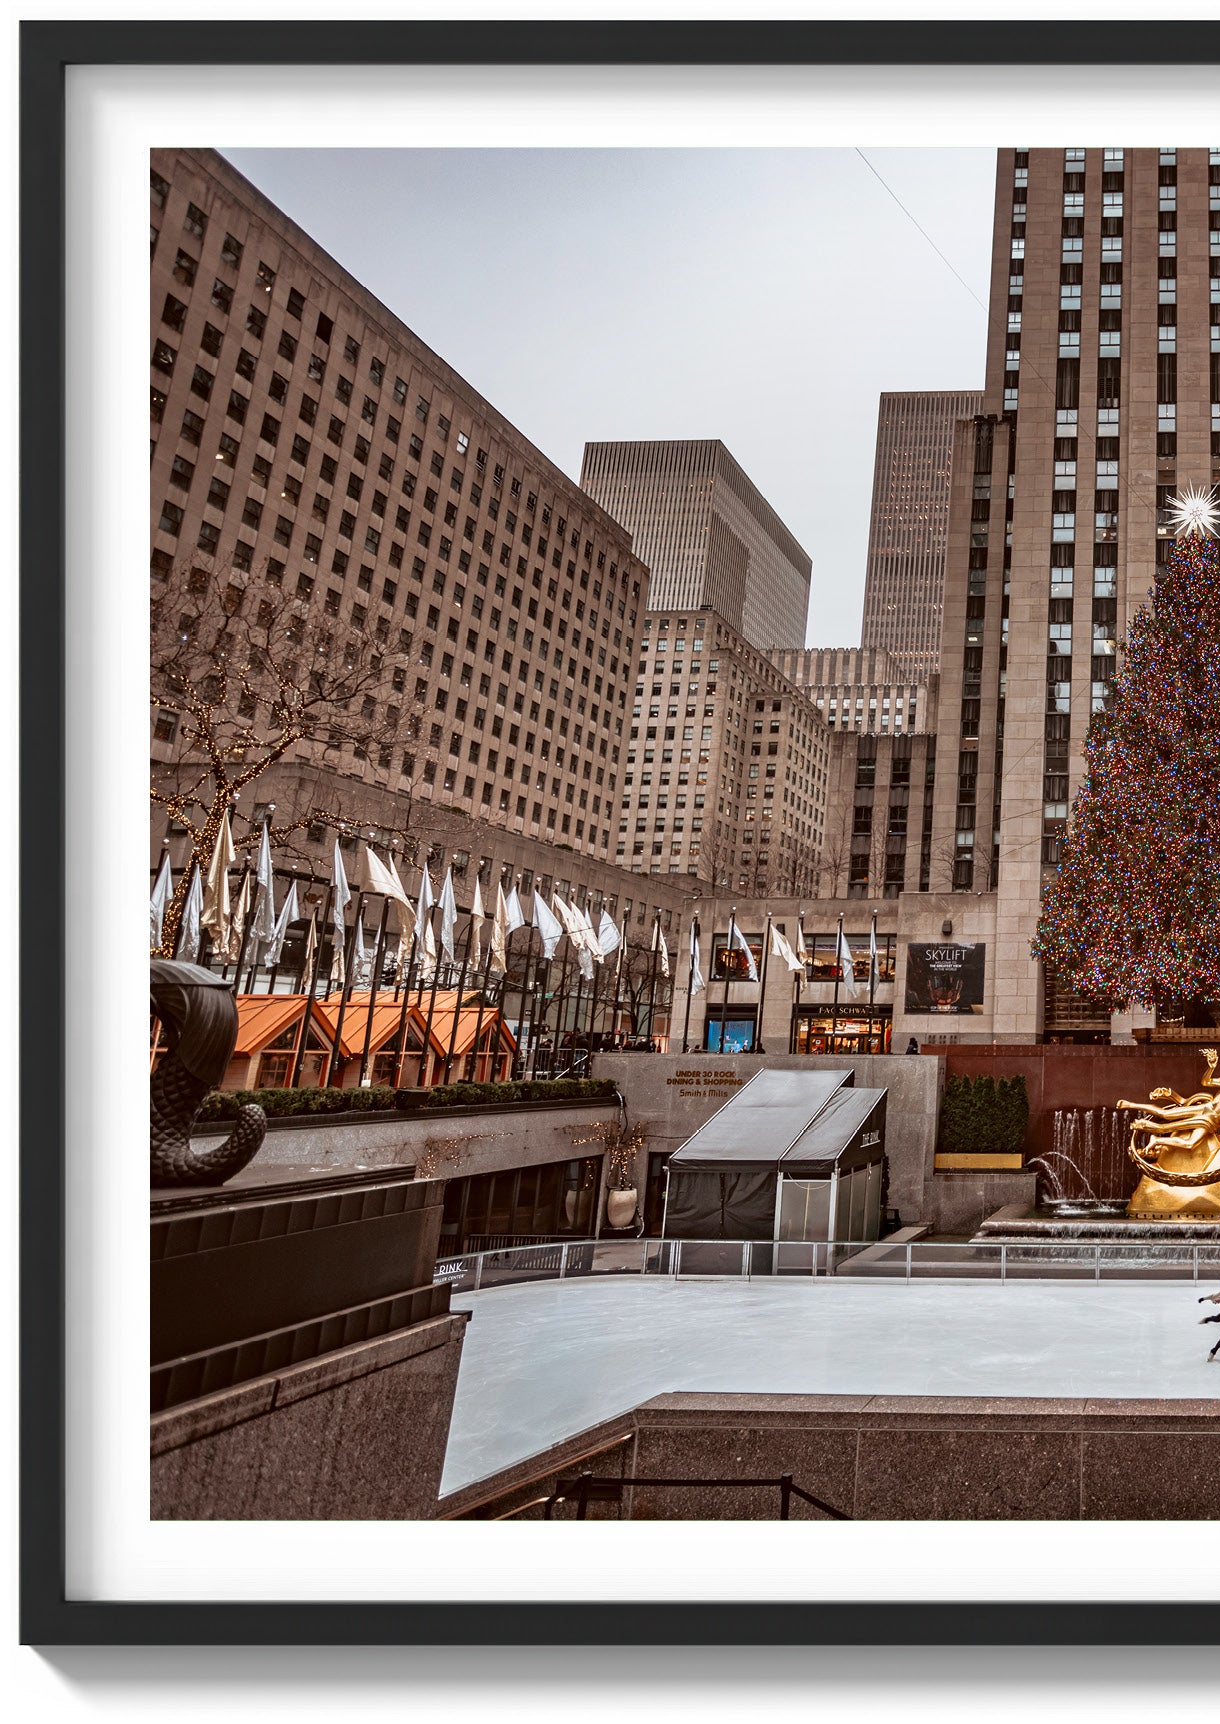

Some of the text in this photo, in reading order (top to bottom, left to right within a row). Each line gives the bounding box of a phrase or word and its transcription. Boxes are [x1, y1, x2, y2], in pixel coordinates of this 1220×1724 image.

[925, 949, 967, 961] SKYLIFT
[680, 1089, 701, 1097] Smith
[709, 1089, 728, 1097] Mills
[439, 1262, 463, 1274] RINK
